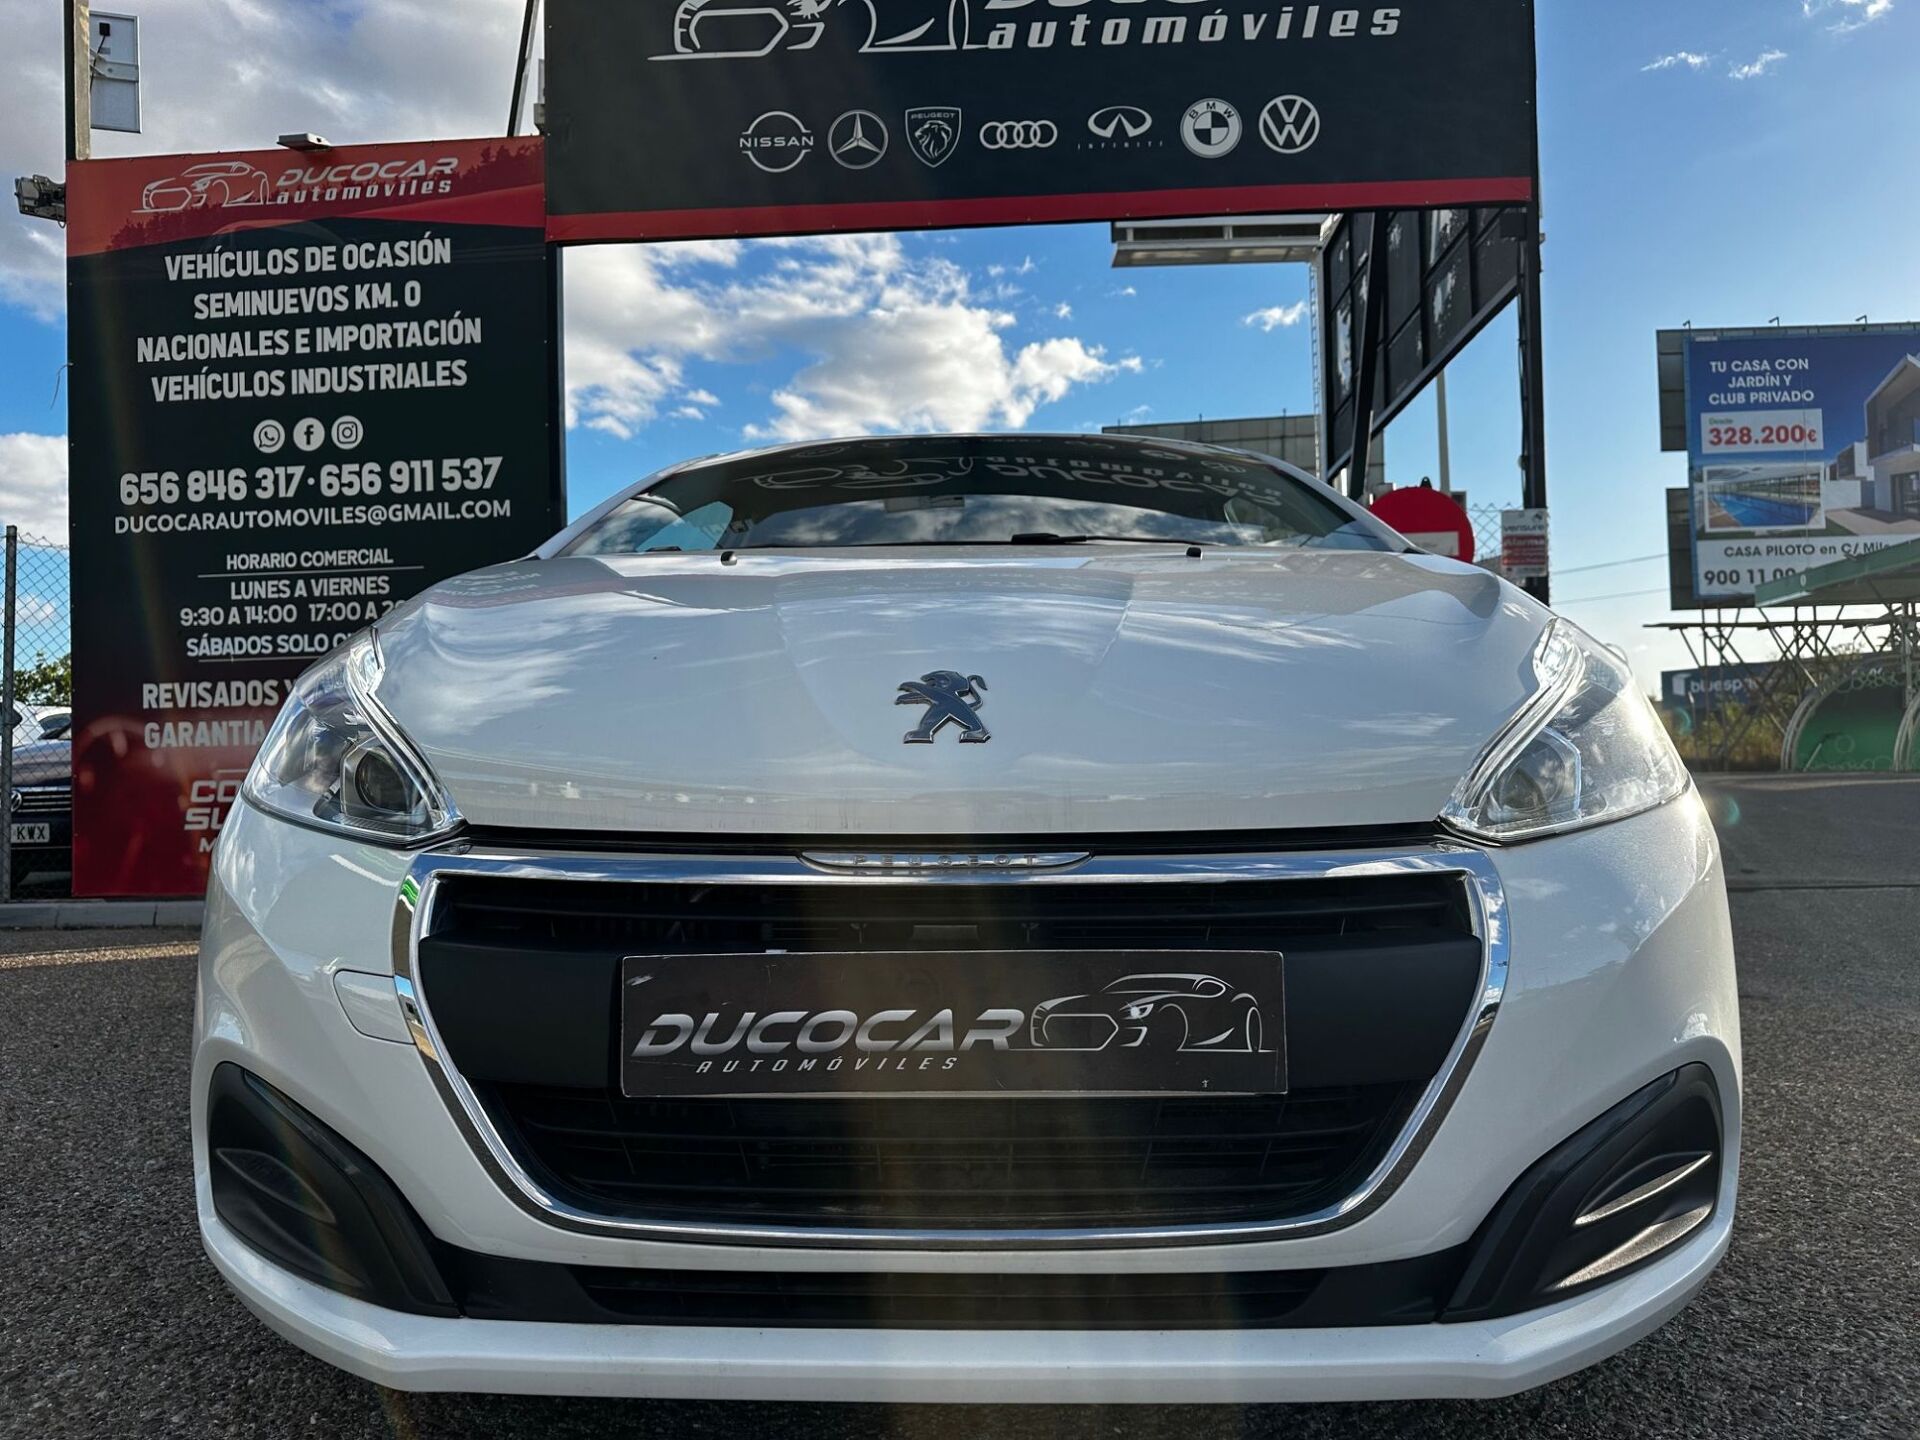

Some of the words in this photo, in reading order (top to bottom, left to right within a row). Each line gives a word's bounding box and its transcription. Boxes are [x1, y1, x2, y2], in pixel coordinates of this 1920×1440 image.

[987, 5, 1400, 50] automóviles
[911, 112, 957, 120] PEUGEOT
[1188, 101, 1234, 119] BMW
[740, 136, 814, 148] NISSAN
[276, 157, 459, 187] DUCOCAR
[277, 179, 451, 204] automóviles
[165, 246, 299, 281] VEHÍCULOS
[304, 246, 337, 273] DE
[342, 231, 451, 271] OCASIÓN
[194, 284, 349, 320] SEMINUEVOS
[354, 282, 399, 310] KM.
[137, 329, 289, 363] NACIONALES
[295, 328, 310, 354] E
[316, 311, 482, 352] IMPORTACIÓN
[1709, 361, 1727, 373] TU
[1731, 360, 1771, 372] CASA
[1775, 358, 1809, 370] CON
[151, 366, 285, 402] VEHÍCULOS
[291, 359, 468, 395] INDUSTRIALES
[1728, 372, 1780, 388] JARDÍN
[1783, 375, 1792, 386] Y
[1708, 393, 1746, 405] CLUB
[1750, 390, 1815, 403] PRIVADO
[120, 471, 180, 505] 656
[187, 468, 247, 502] 846
[389, 459, 435, 493] 911
[441, 456, 503, 491] 537
[115, 499, 512, 534] DUCOCARAUTOMOVILES@GMAIL.COM
[226, 552, 298, 570] HORARIO
[300, 548, 394, 568] COMERCIAL
[1724, 545, 1762, 558] CASA
[1766, 544, 1816, 556] PILOTO
[1820, 544, 1837, 556] en
[231, 579, 291, 600] LUNES
[294, 579, 307, 597] A
[310, 575, 390, 597] VIERNES
[1704, 570, 1741, 585] 900
[1749, 569, 1765, 584] 11
[180, 606, 225, 626] 9:30
[228, 606, 241, 625] A
[244, 604, 298, 624] 14:00
[308, 602, 362, 622] 17:00
[364, 601, 378, 620] A
[186, 633, 273, 657] SÁBADOS
[277, 633, 329, 653] SOLO
[142, 679, 280, 709] REVISADOS
[16, 825, 46, 840] KWX
[852, 854, 1037, 866] PEUGEOT
[631, 1008, 1026, 1057] DUCOCAR
[696, 1056, 959, 1073] AUTOMÓVILES
